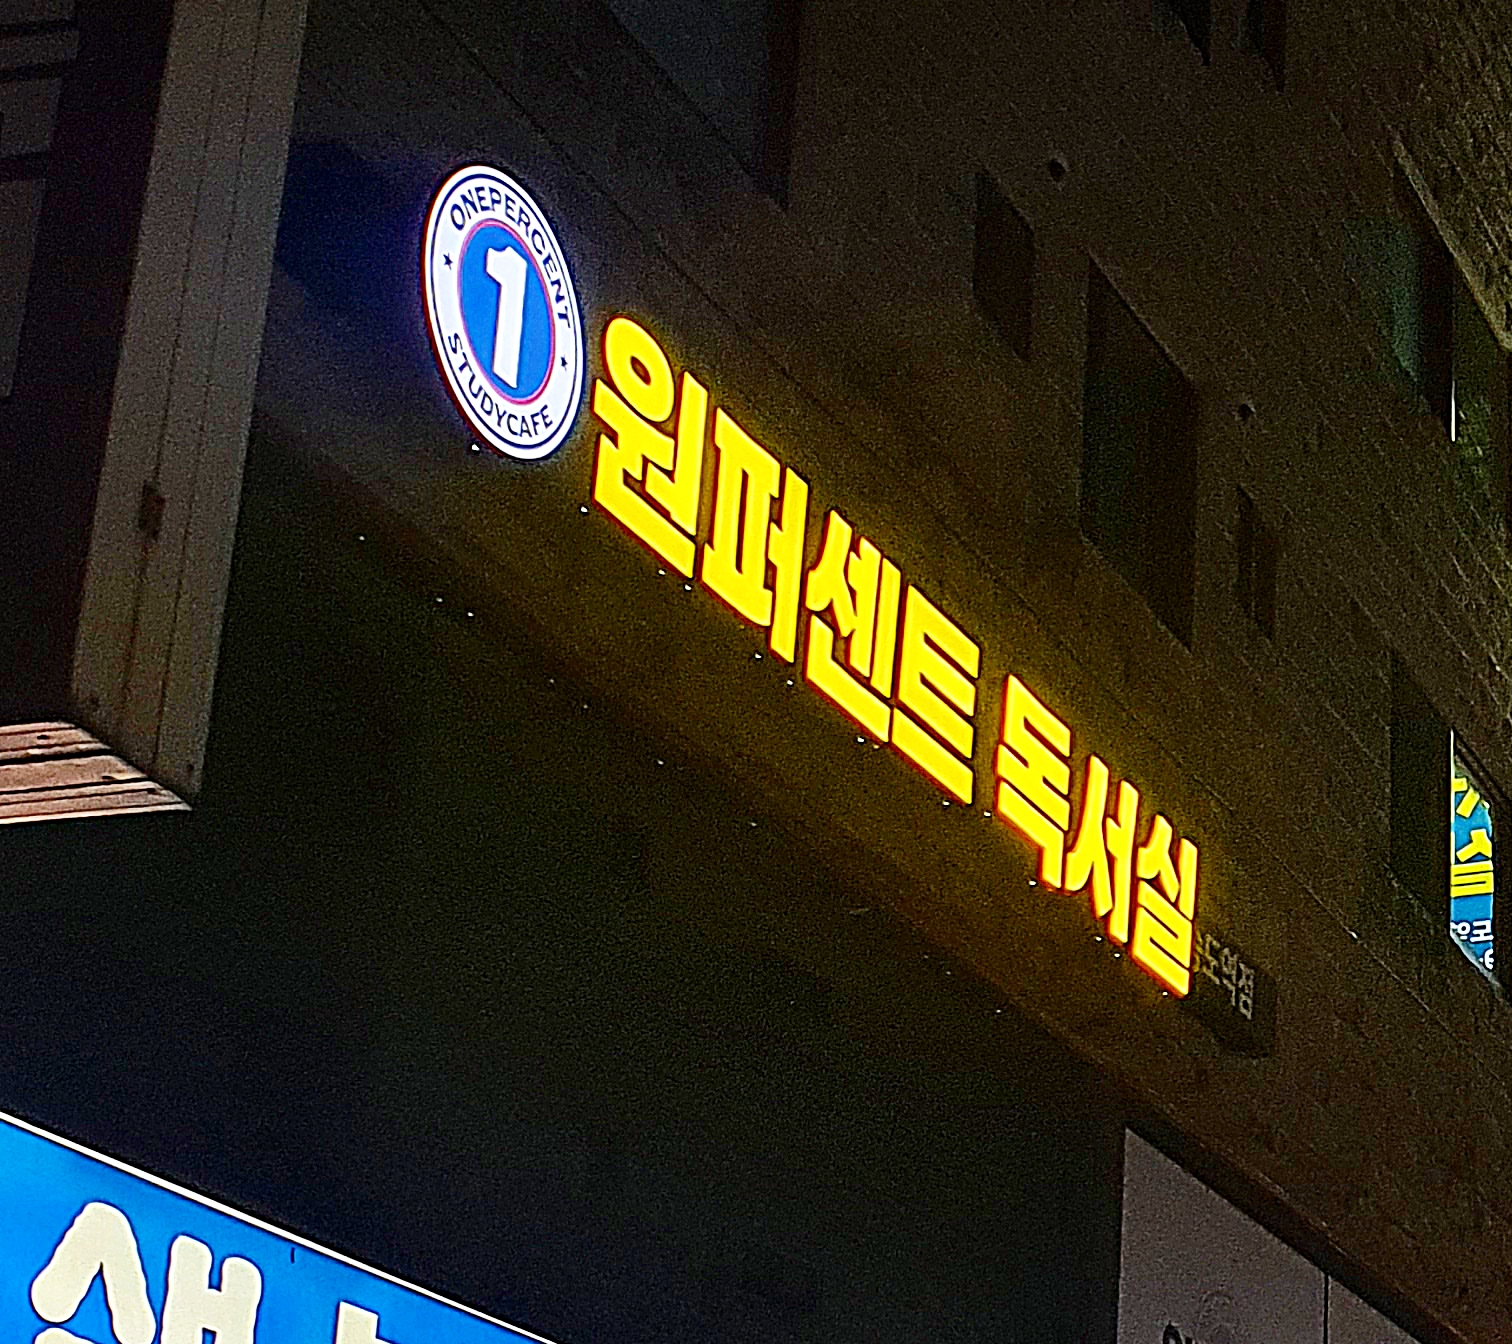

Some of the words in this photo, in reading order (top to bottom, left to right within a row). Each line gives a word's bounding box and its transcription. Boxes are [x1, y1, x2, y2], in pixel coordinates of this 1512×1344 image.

[449, 183, 573, 330] ONEPERCENT
[485, 245, 527, 389] 1
[445, 330, 555, 440] STUDYCAFE
[592, 315, 983, 806] 원퍼센트
[995, 674, 1200, 997] 독서실
